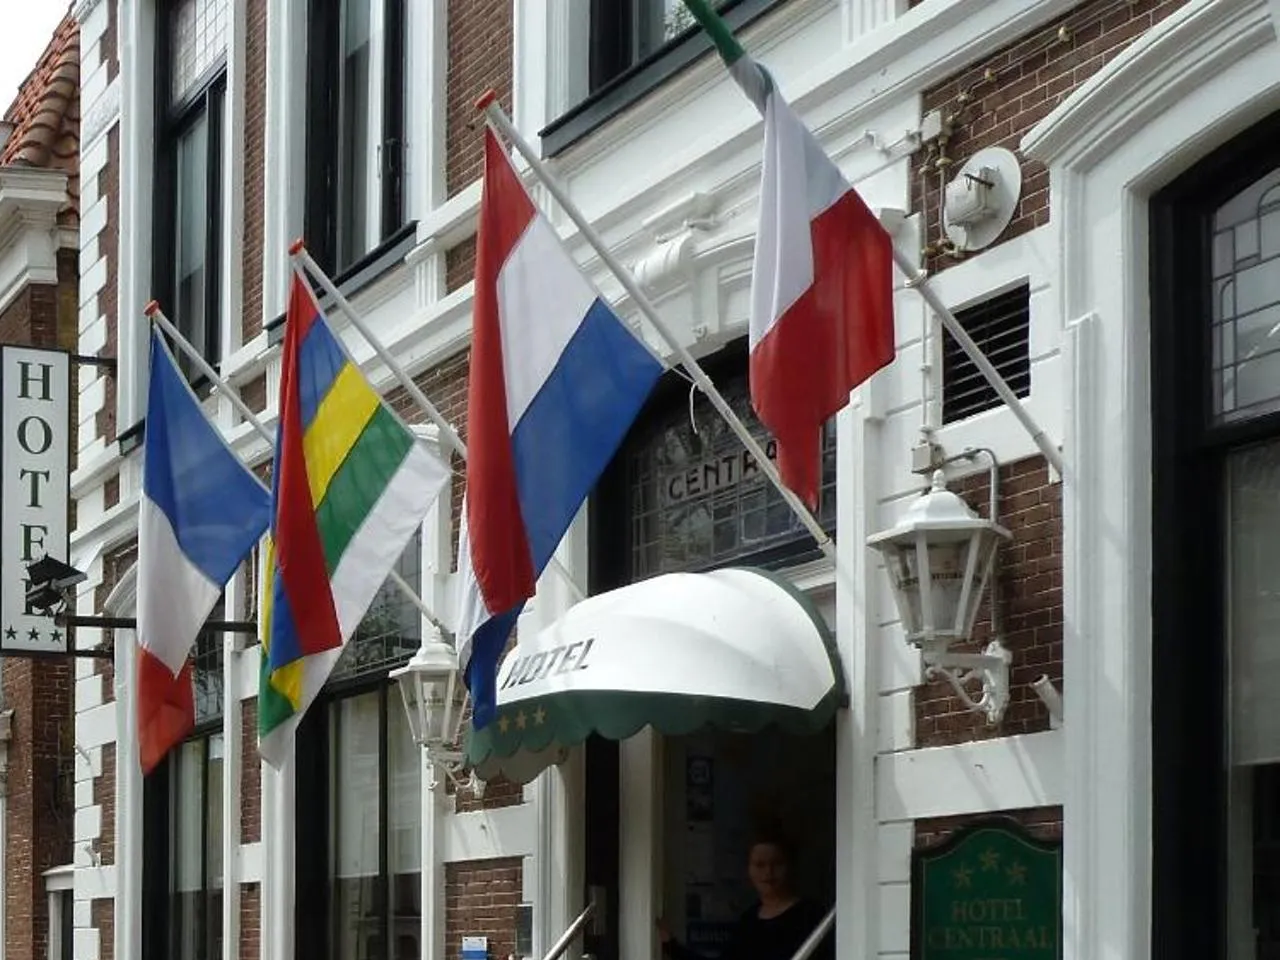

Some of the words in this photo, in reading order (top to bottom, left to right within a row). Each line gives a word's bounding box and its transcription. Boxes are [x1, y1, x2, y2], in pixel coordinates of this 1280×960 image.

[668, 439, 778, 500] CENTRA
[500, 637, 596, 691] HOTEL
[951, 898, 1027, 922] HOTEL
[928, 925, 1053, 949] CENTRAAL
